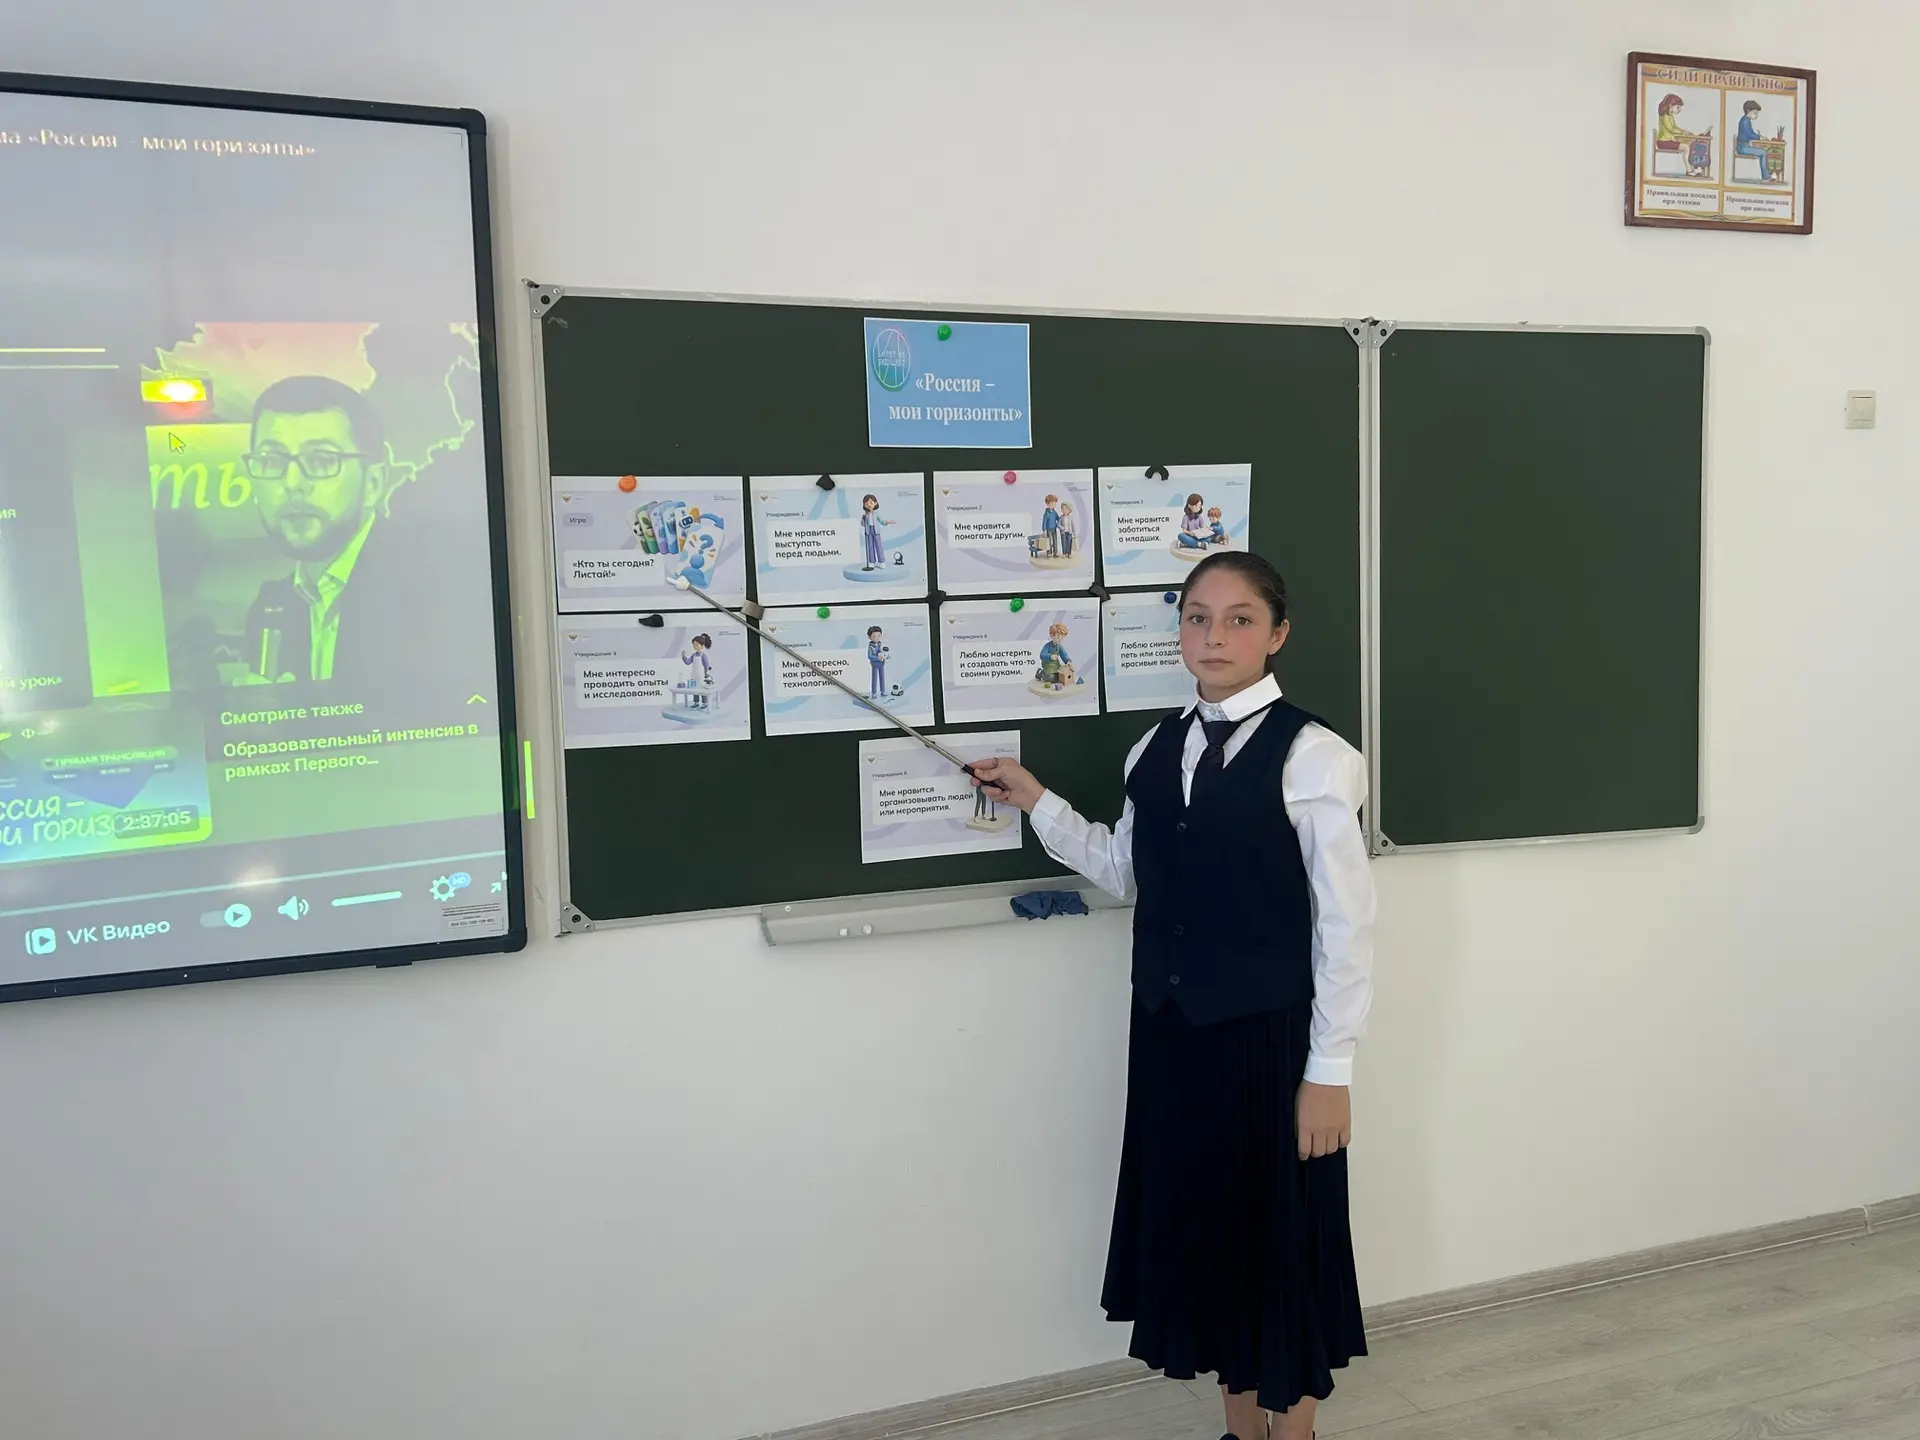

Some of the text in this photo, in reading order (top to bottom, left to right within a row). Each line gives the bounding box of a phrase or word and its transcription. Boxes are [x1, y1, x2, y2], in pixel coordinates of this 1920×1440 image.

[142, 136, 187, 151] мои
[915, 372, 981, 392] «Россия
[888, 406, 1023, 425] мои горизонты»
[569, 517, 587, 525] Игра
[1135, 516, 1170, 525] нравится
[954, 523, 1011, 532] Мне нравится
[1118, 525, 1160, 534] заботиться
[774, 529, 836, 540] Мне нравится
[954, 531, 1026, 541] помогать другим.
[1125, 535, 1161, 543] младших.
[775, 540, 822, 550] выступать
[775, 549, 842, 559] перед людьми.
[572, 560, 595, 568] «Кто
[612, 559, 655, 569] сегодня?
[573, 570, 616, 579] Листай!»
[960, 650, 1032, 659] Люблю мастерить
[782, 661, 800, 669] Мне
[967, 661, 1008, 669] создавать
[1121, 660, 1158, 669] красивые
[583, 669, 656, 679] Мне интересно
[782, 671, 798, 679] как
[991, 670, 1023, 678] руками.
[19, 675, 63, 691] урок»
[583, 679, 669, 690] проводить опыты
[592, 690, 663, 700] исследования.
[220, 703, 364, 725] Смотрите также
[223, 724, 478, 758] Образовательный интенсив в
[225, 762, 290, 782] рамках
[879, 787, 935, 797] Мне нравится
[879, 792, 974, 808] организовывать людей
[896, 804, 951, 815] мероприятия.
[123, 810, 191, 831] 2:37:05
[67, 920, 171, 944] VK Видео
